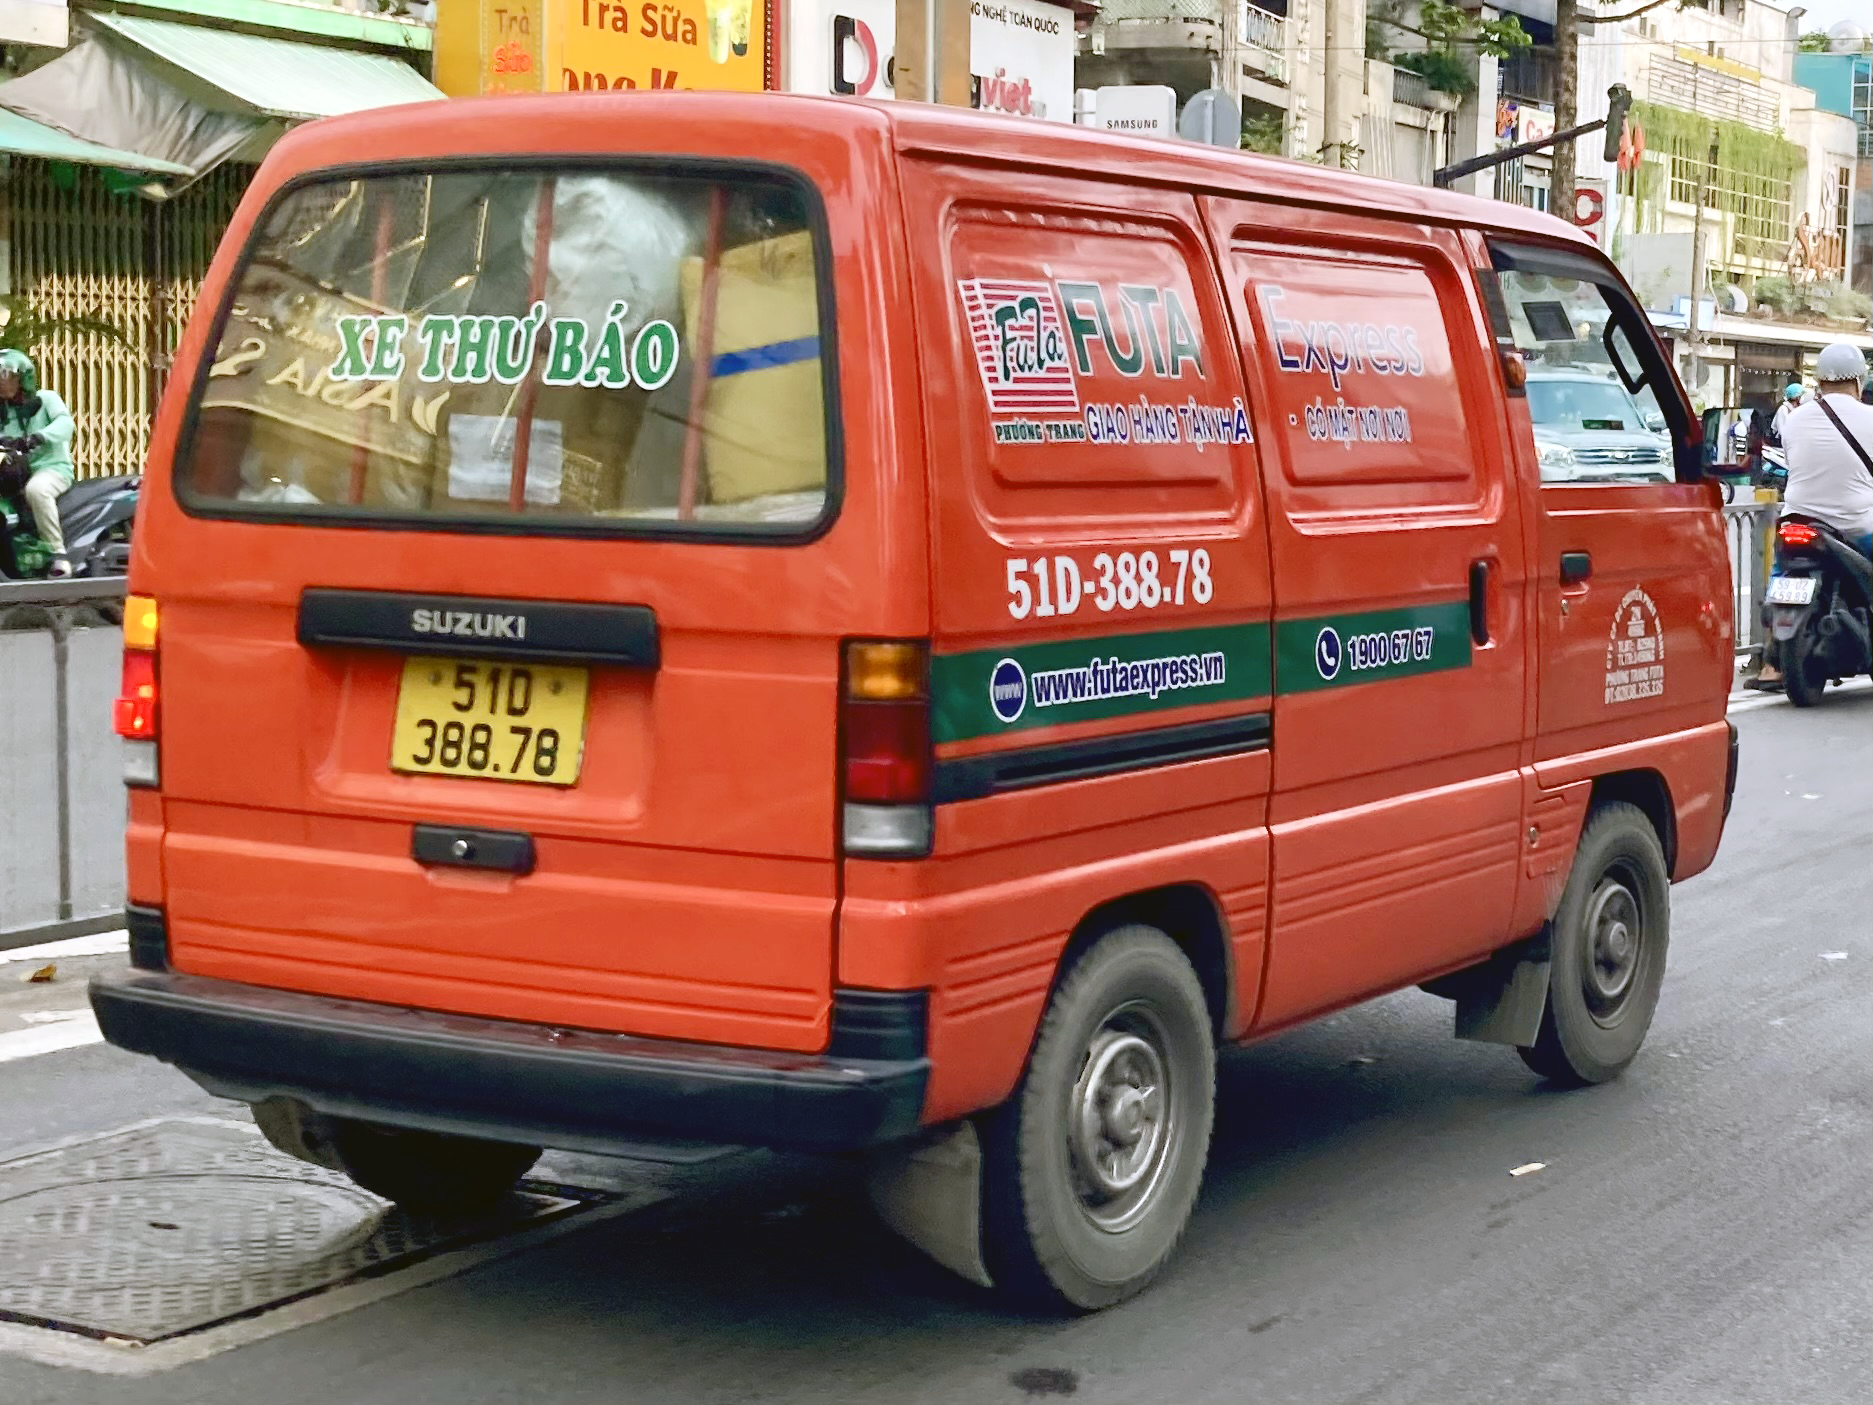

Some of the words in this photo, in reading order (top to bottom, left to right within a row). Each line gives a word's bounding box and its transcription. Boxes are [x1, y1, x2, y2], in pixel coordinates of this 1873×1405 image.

[640, 3, 698, 46] Sữa
[1106, 119, 1158, 130] SAMSUNG
[331, 315, 409, 381] XE
[417, 299, 548, 386] THƯ
[543, 299, 680, 391] BÁO
[1057, 281, 1206, 381] FUTA
[1255, 284, 1424, 391] Express
[1043, 421, 1086, 443] TRANG
[1084, 402, 1130, 444] GIAO
[1128, 393, 1179, 444] HÀNG
[1006, 548, 1213, 620] 51D-388.78
[411, 608, 528, 641] SUZUKI
[1347, 635, 1389, 671] 1900
[1390, 629, 1412, 665] 67
[1412, 626, 1434, 660] 67
[451, 664, 535, 717] 51D
[1031, 651, 1226, 708] www.futaexpress.vn
[412, 718, 560, 777] 388.78
